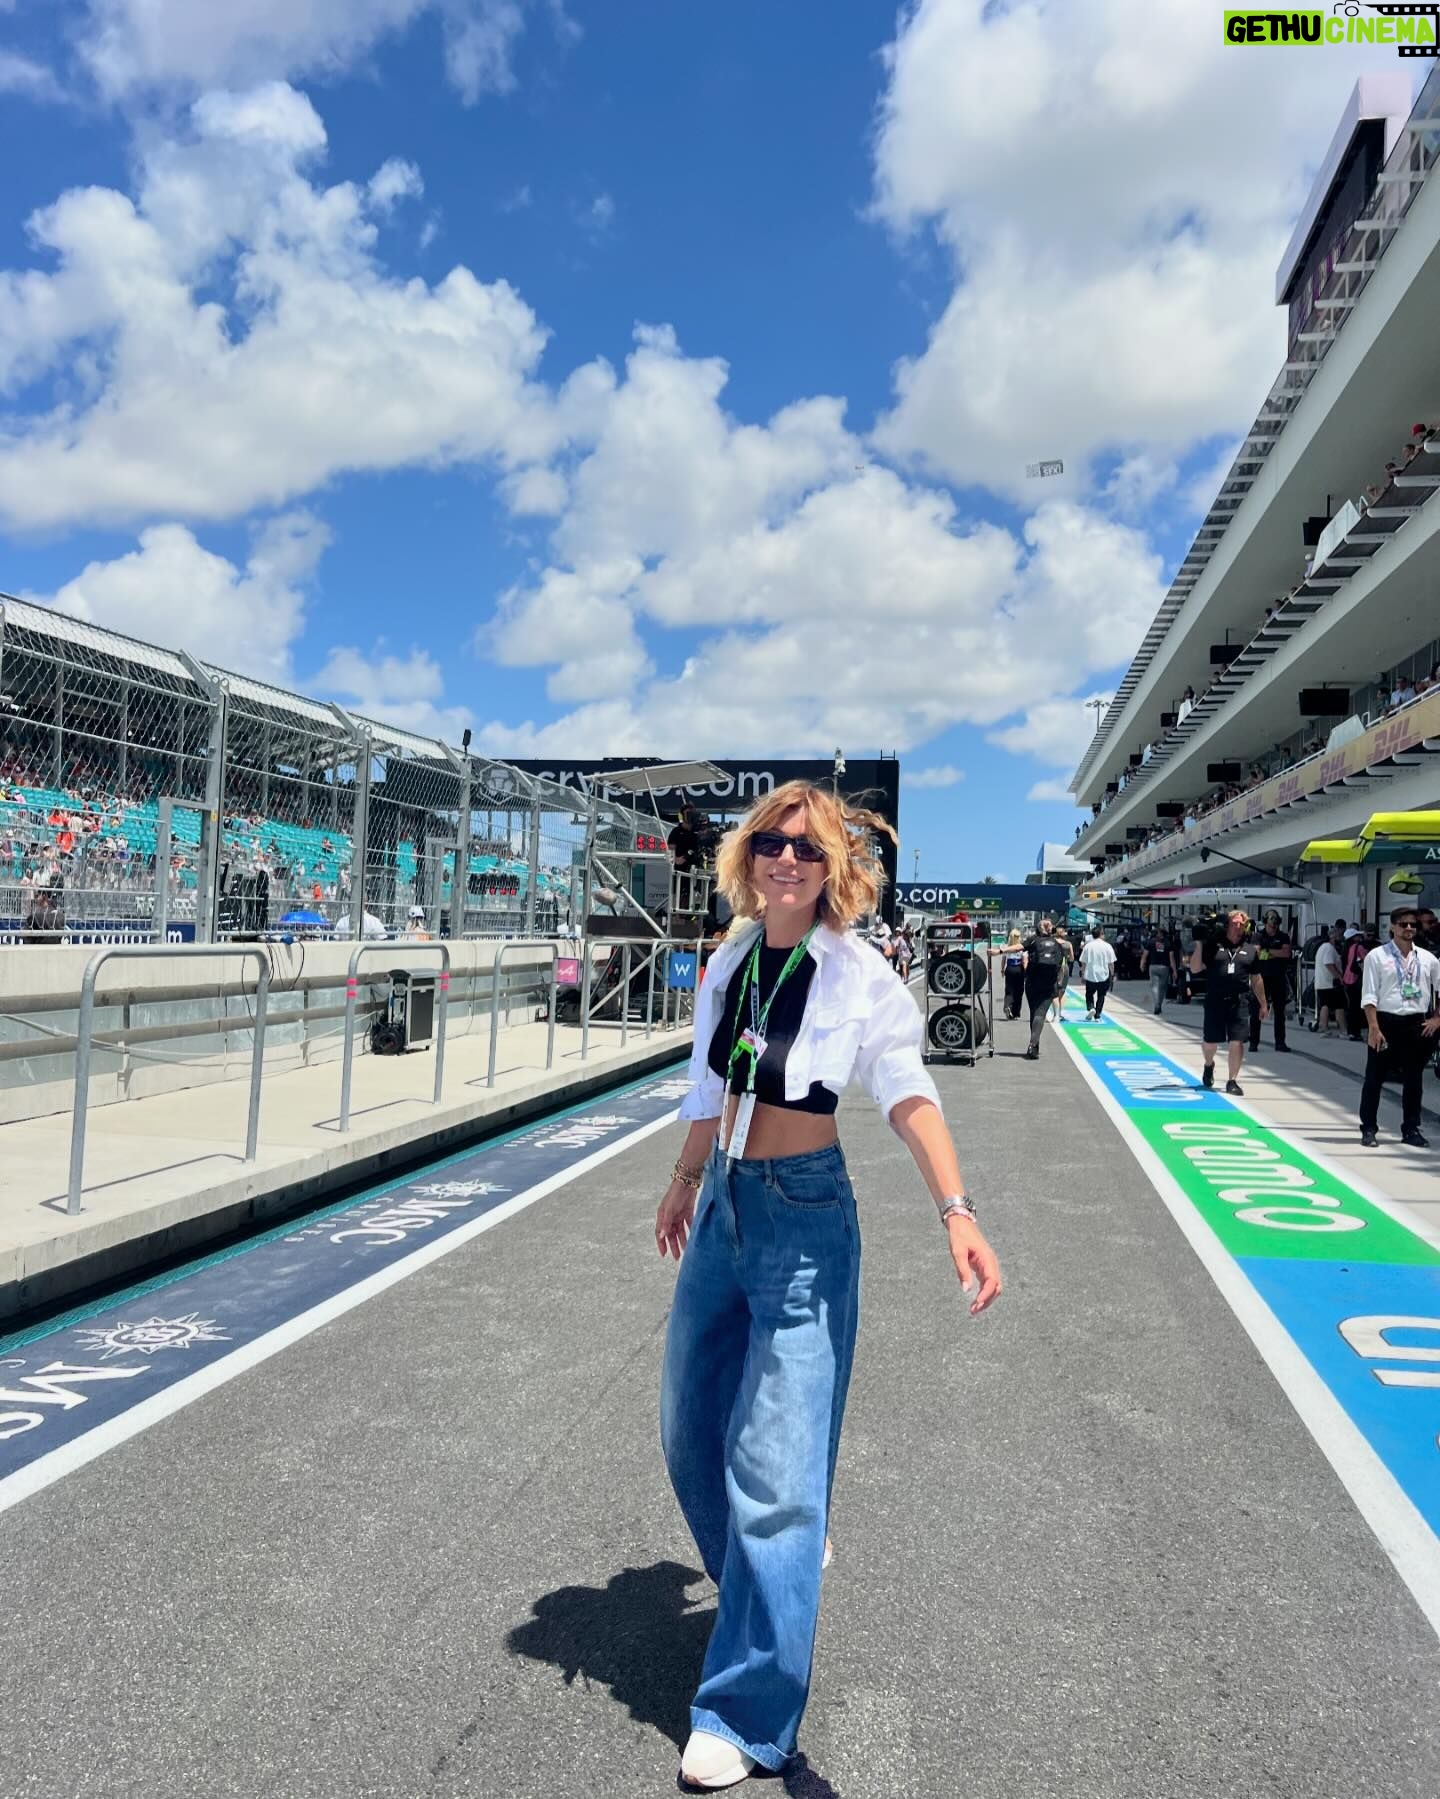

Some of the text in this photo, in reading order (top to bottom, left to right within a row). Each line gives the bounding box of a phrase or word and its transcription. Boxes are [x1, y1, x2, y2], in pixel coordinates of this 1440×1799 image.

[537, 766, 775, 802] cryp.com
[674, 963, 690, 976] W
[1162, 1122, 1368, 1232] aramco
[330, 1198, 474, 1245] MSC
